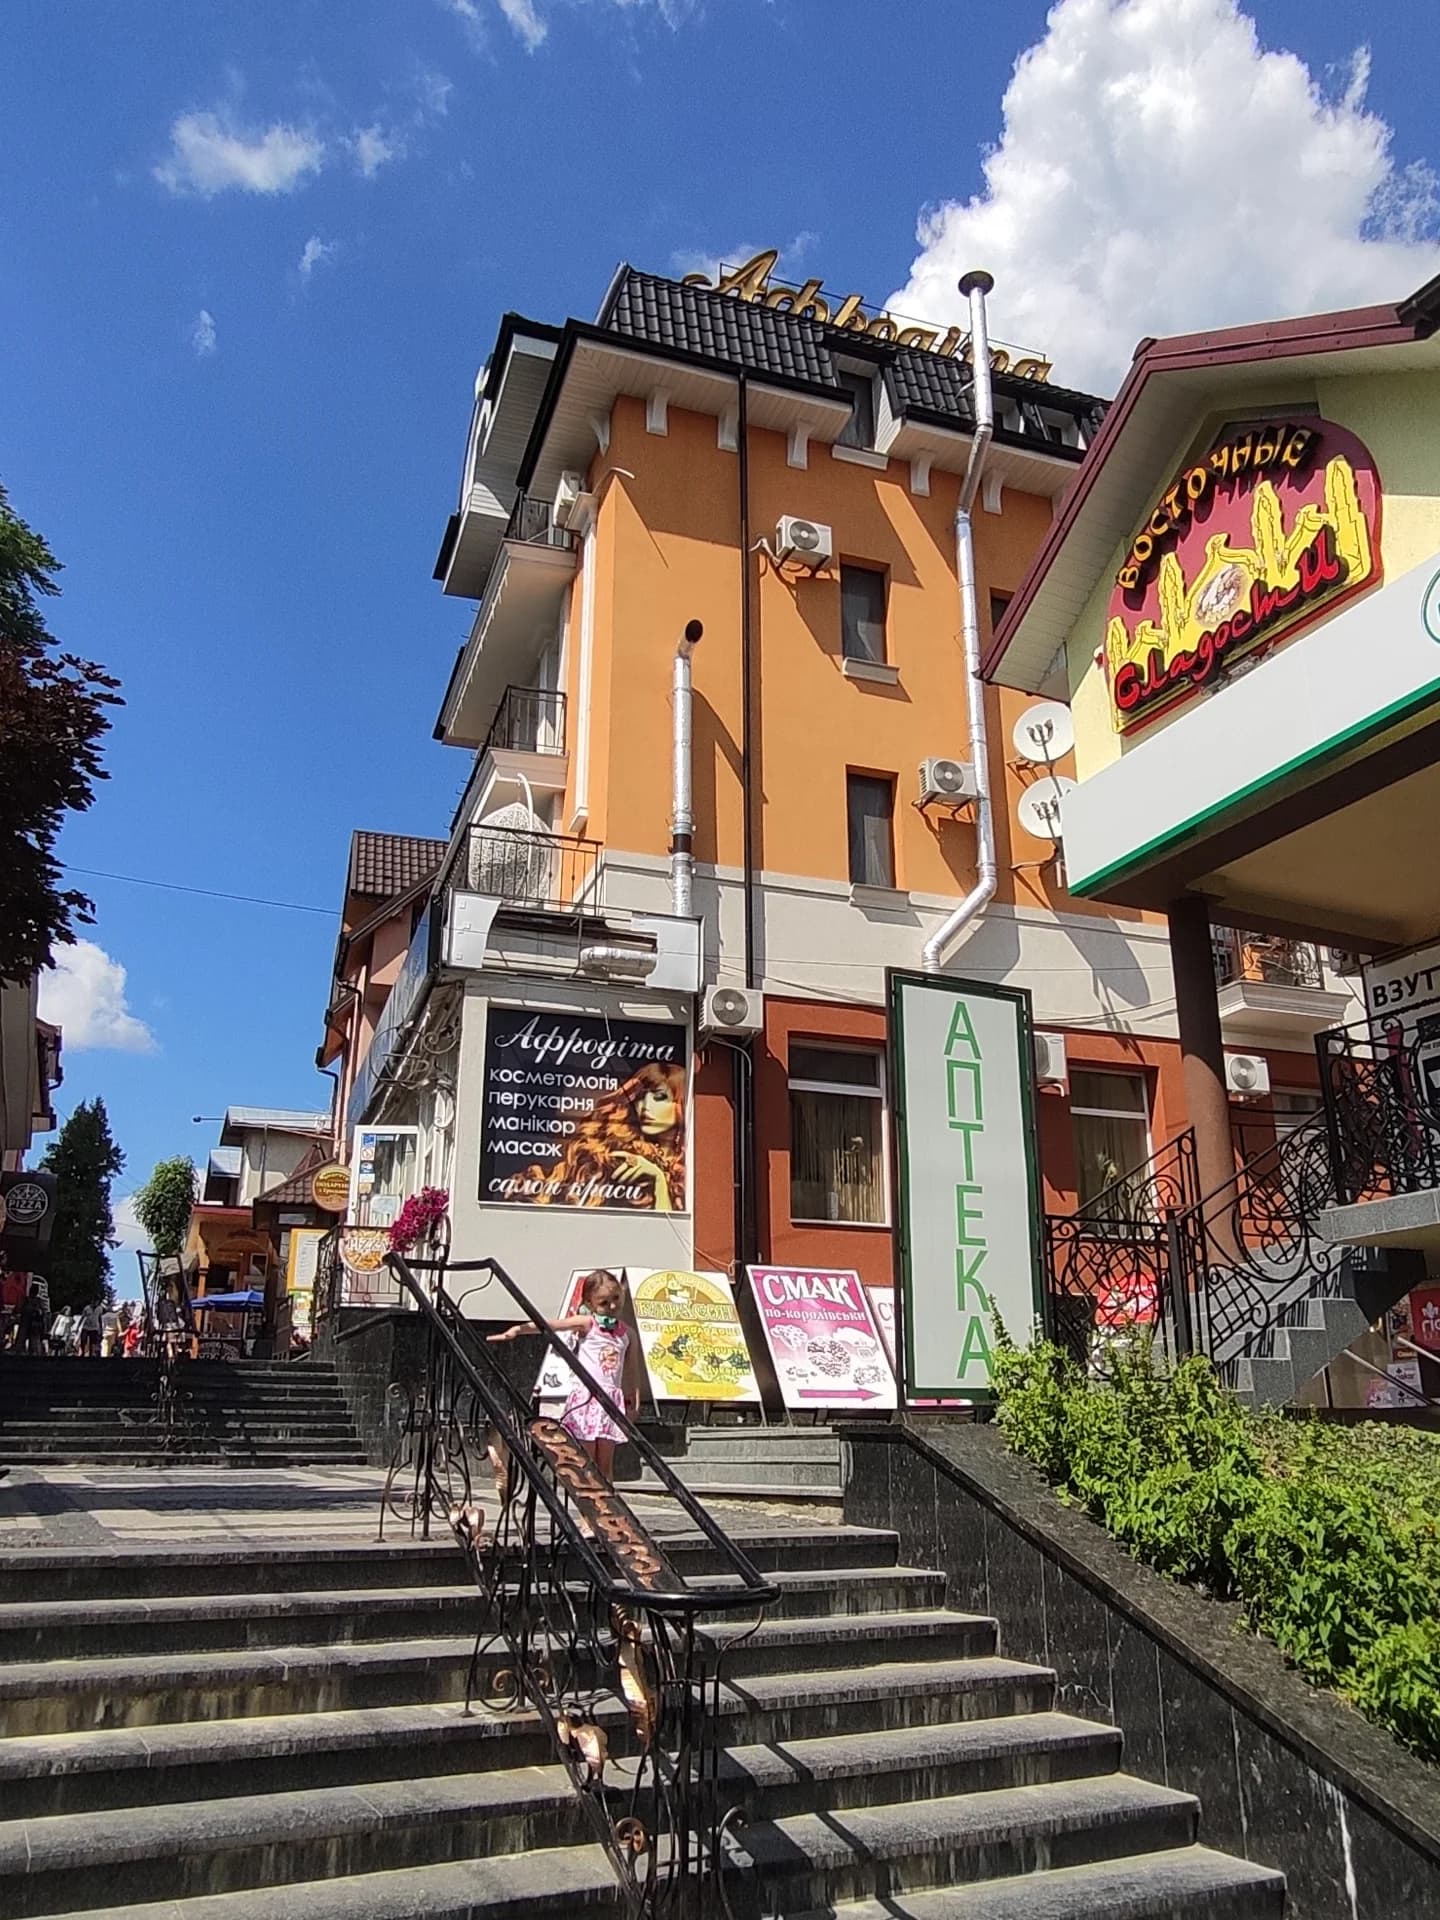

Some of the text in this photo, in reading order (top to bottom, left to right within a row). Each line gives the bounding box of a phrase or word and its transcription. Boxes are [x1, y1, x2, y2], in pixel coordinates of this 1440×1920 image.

[494, 1015, 674, 1069] Афродіта
[489, 1067, 618, 1091] косметологія
[488, 1091, 595, 1112] перукарня
[487, 1114, 576, 1135] манікюр
[486, 1138, 563, 1157] масаж
[488, 1174, 644, 1207] салон краси
[943, 1000, 995, 1380] АПТЕКА
[8, 1199, 42, 1209] PIZZA
[762, 1274, 859, 1311] СМАК
[764, 1306, 867, 1323] по-королівськи
